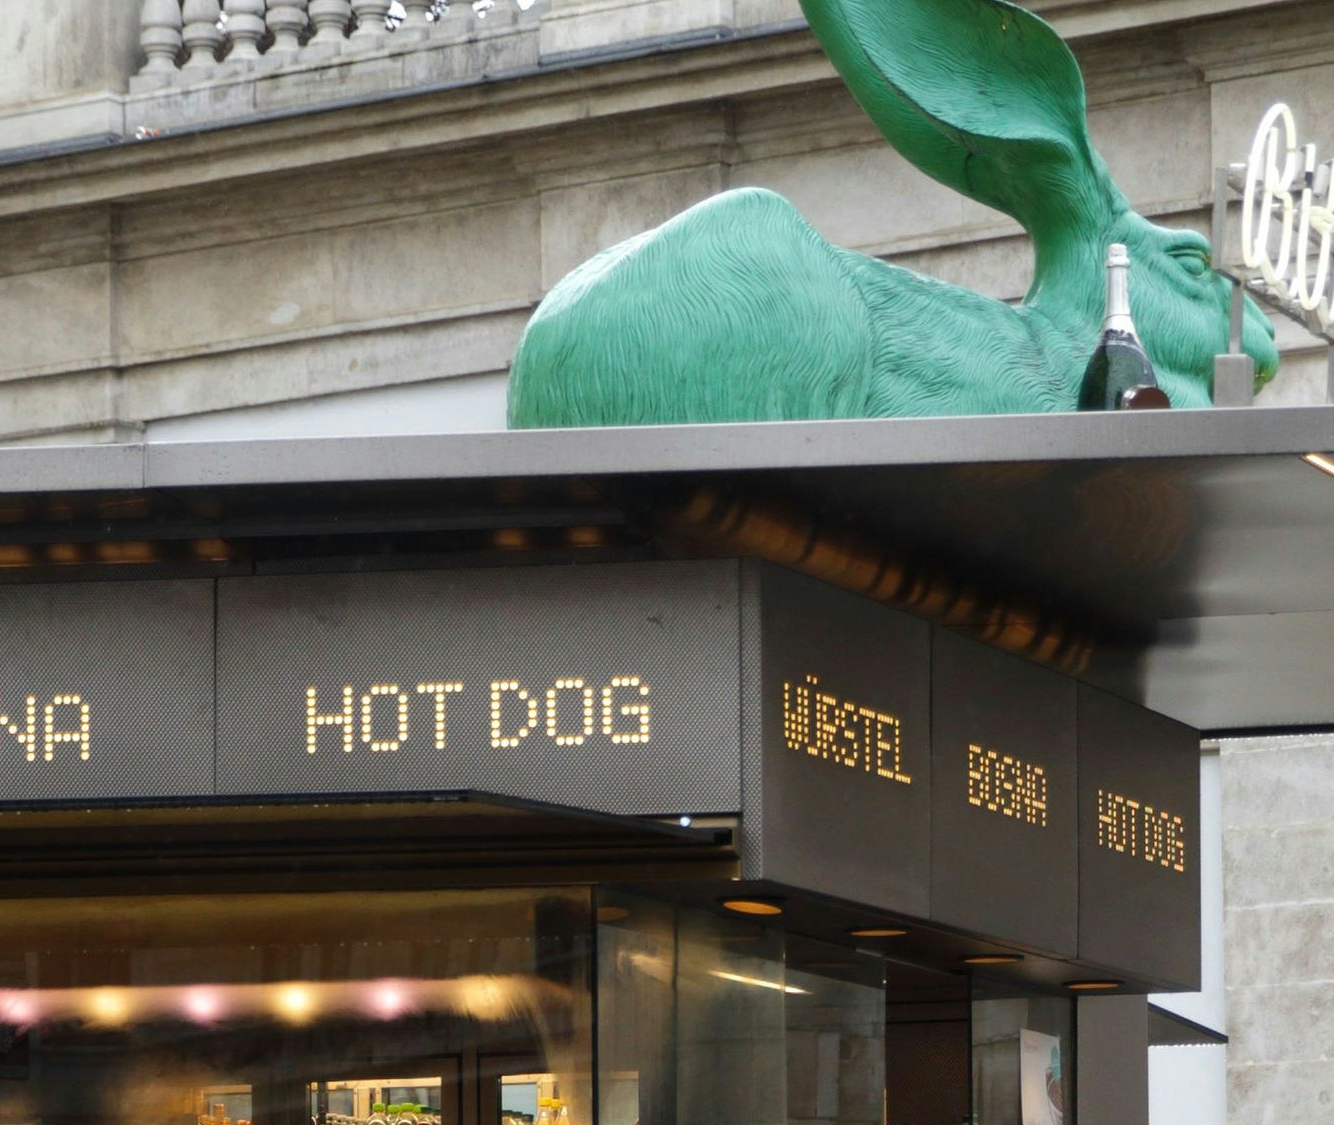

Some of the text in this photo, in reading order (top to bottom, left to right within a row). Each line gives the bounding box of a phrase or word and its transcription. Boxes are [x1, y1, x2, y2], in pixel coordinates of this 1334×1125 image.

[306, 676, 650, 754] HOT DOG
[783, 674, 912, 785] WÜRSTEL
[968, 743, 1047, 828] BOSNA
[1098, 789, 1184, 872] HOT DOG
